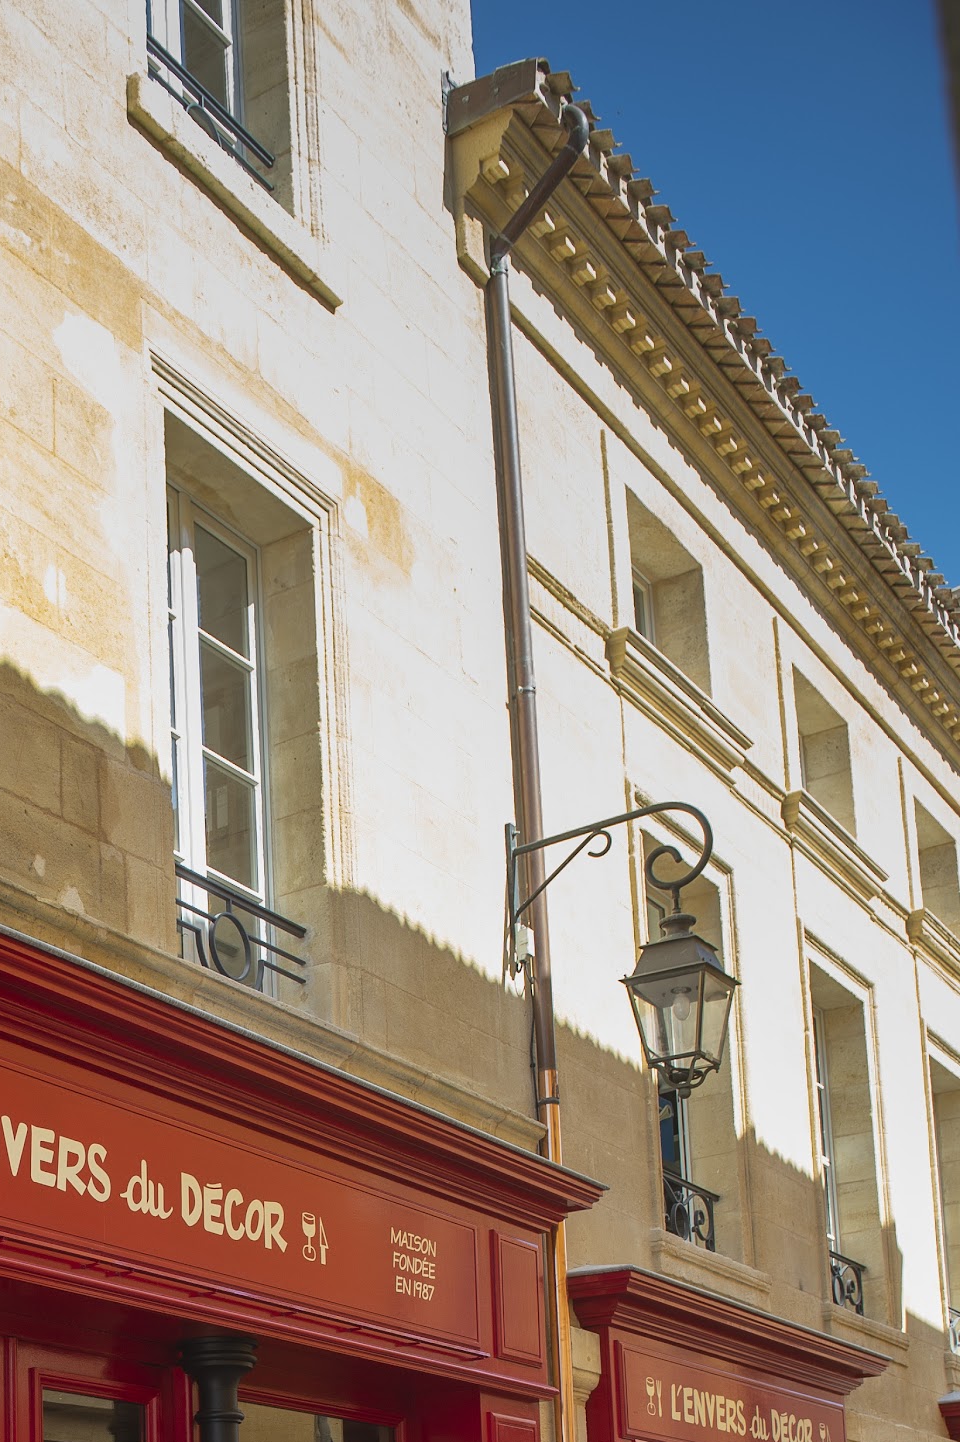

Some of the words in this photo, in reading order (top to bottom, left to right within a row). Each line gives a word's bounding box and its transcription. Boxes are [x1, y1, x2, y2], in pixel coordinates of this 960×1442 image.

[120, 1159, 173, 1219] du
[180, 1172, 288, 1253] DÉCOR
[391, 1227, 436, 1257] MAISON
[393, 1251, 435, 1279] FONDÉE
[396, 1275, 411, 1295] EN
[414, 1280, 434, 1301] 1987
[671, 1383, 746, 1436] L'ENVERS
[749, 1405, 769, 1441] du
